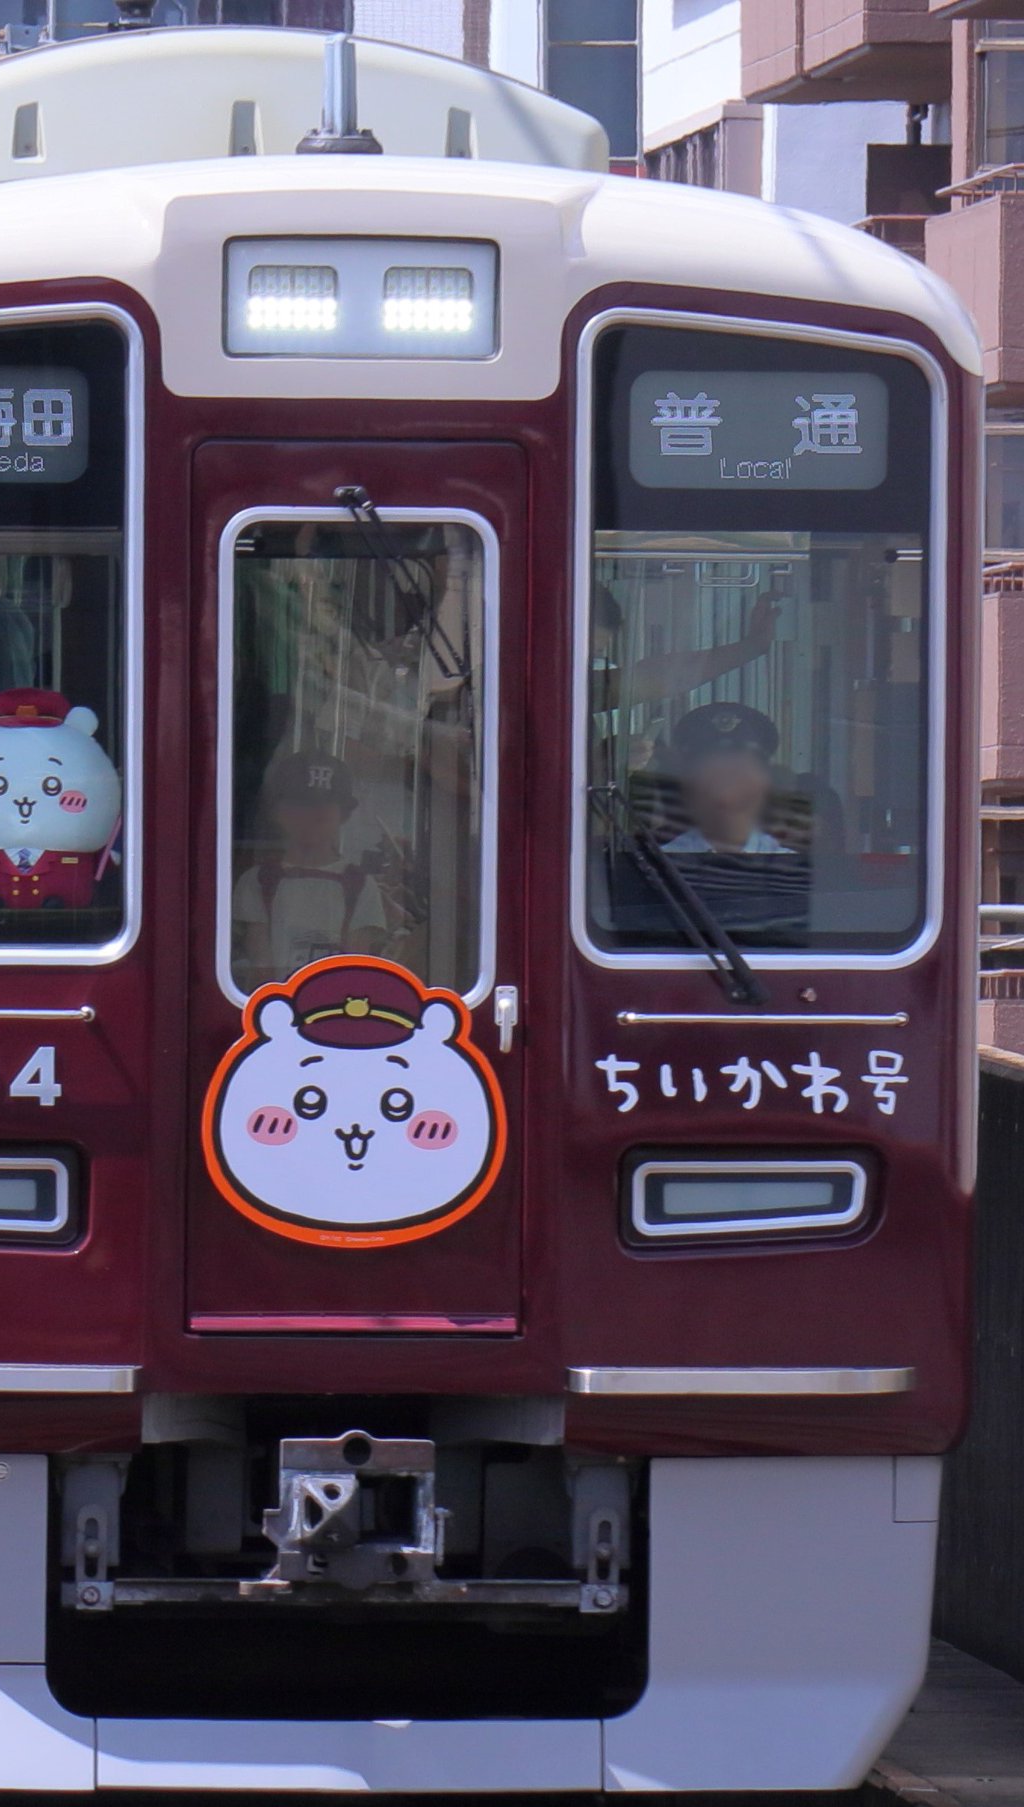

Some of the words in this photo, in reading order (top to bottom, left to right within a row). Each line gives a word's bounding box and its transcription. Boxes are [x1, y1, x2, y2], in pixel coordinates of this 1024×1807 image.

[650, 391, 863, 455] 普通
[719, 457, 792, 480] Local
[594, 1050, 909, 1115] ちいかわ号
